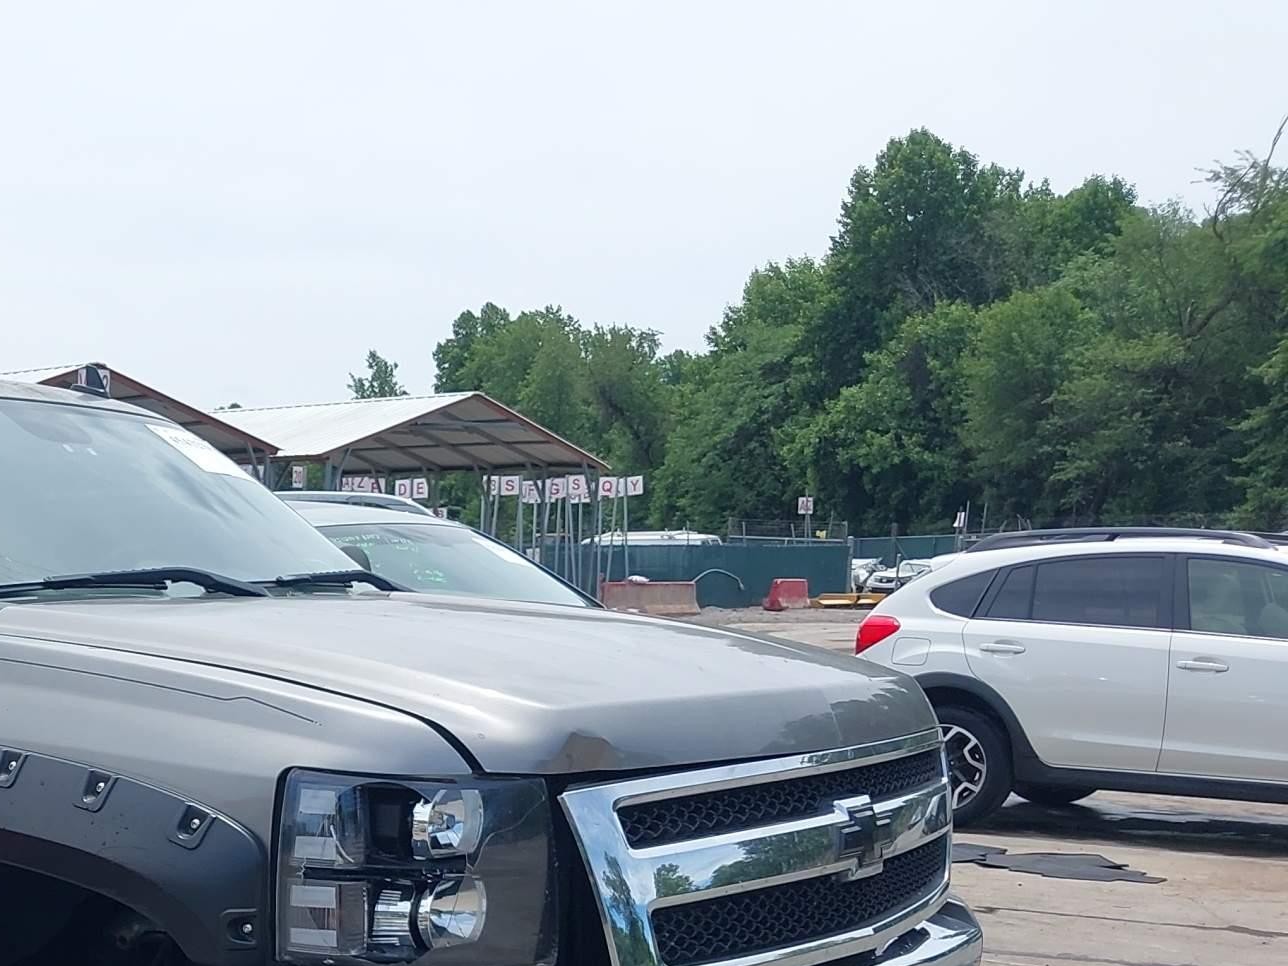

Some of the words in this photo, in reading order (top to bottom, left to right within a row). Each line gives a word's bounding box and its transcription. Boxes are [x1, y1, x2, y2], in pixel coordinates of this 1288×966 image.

[398, 483, 407, 496] D
[416, 482, 424, 495] E
[505, 479, 515, 492] S
[550, 482, 560, 496] G
[572, 478, 580, 490] S
[602, 480, 612, 493] Q
[630, 479, 639, 492] Y
